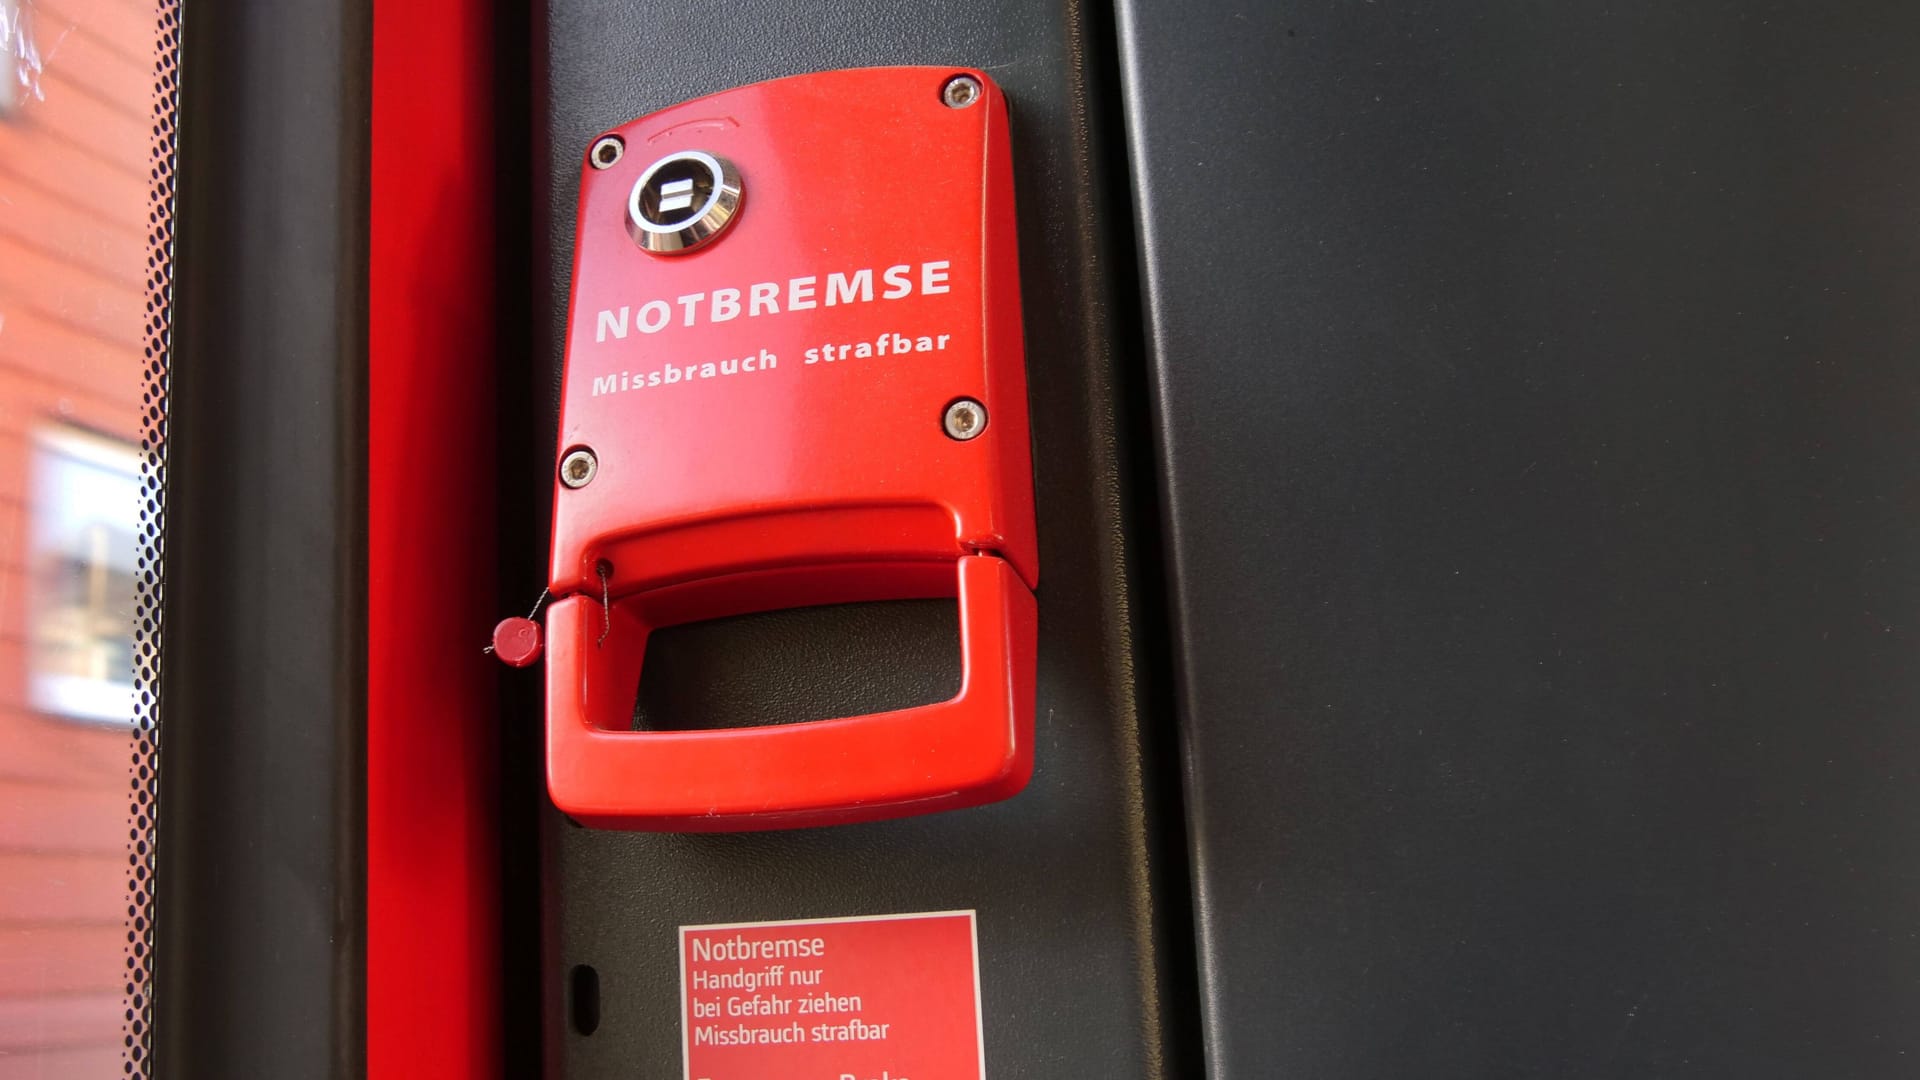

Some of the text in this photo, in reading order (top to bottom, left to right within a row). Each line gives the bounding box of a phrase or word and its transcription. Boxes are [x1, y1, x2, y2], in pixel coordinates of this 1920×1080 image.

[596, 259, 951, 343] NOTBREMSE
[592, 332, 951, 397] Missbrauch strafbar
[692, 935, 825, 963] Notbremse
[692, 965, 823, 993] Handgriff nur
[693, 991, 862, 1018] bei Gefahr ziehen
[694, 1018, 890, 1047] Missbrauch strafbar
